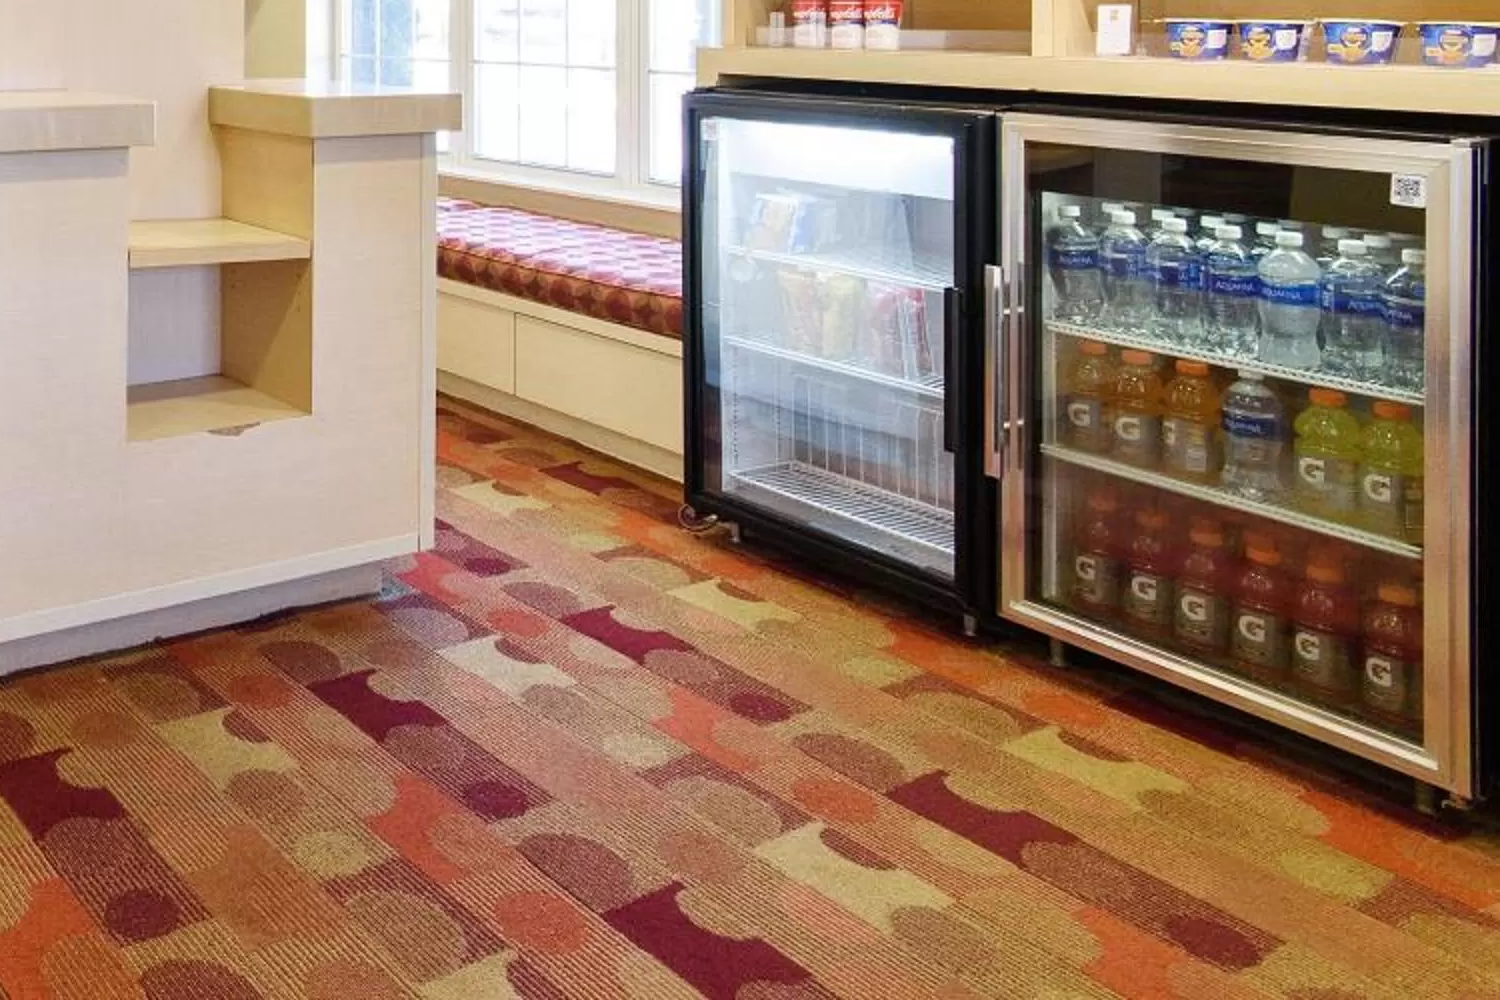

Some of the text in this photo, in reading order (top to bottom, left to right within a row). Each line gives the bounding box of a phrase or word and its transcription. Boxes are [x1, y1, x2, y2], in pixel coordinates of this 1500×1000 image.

[1067, 403, 1091, 427] G
[1115, 416, 1141, 440] G
[1299, 457, 1325, 486] G
[1364, 473, 1391, 503] G
[1075, 555, 1096, 580] G
[1131, 575, 1157, 601] G
[1181, 595, 1207, 621] G
[1239, 615, 1266, 642] G
[1295, 632, 1320, 660] G
[1366, 657, 1392, 687] G
